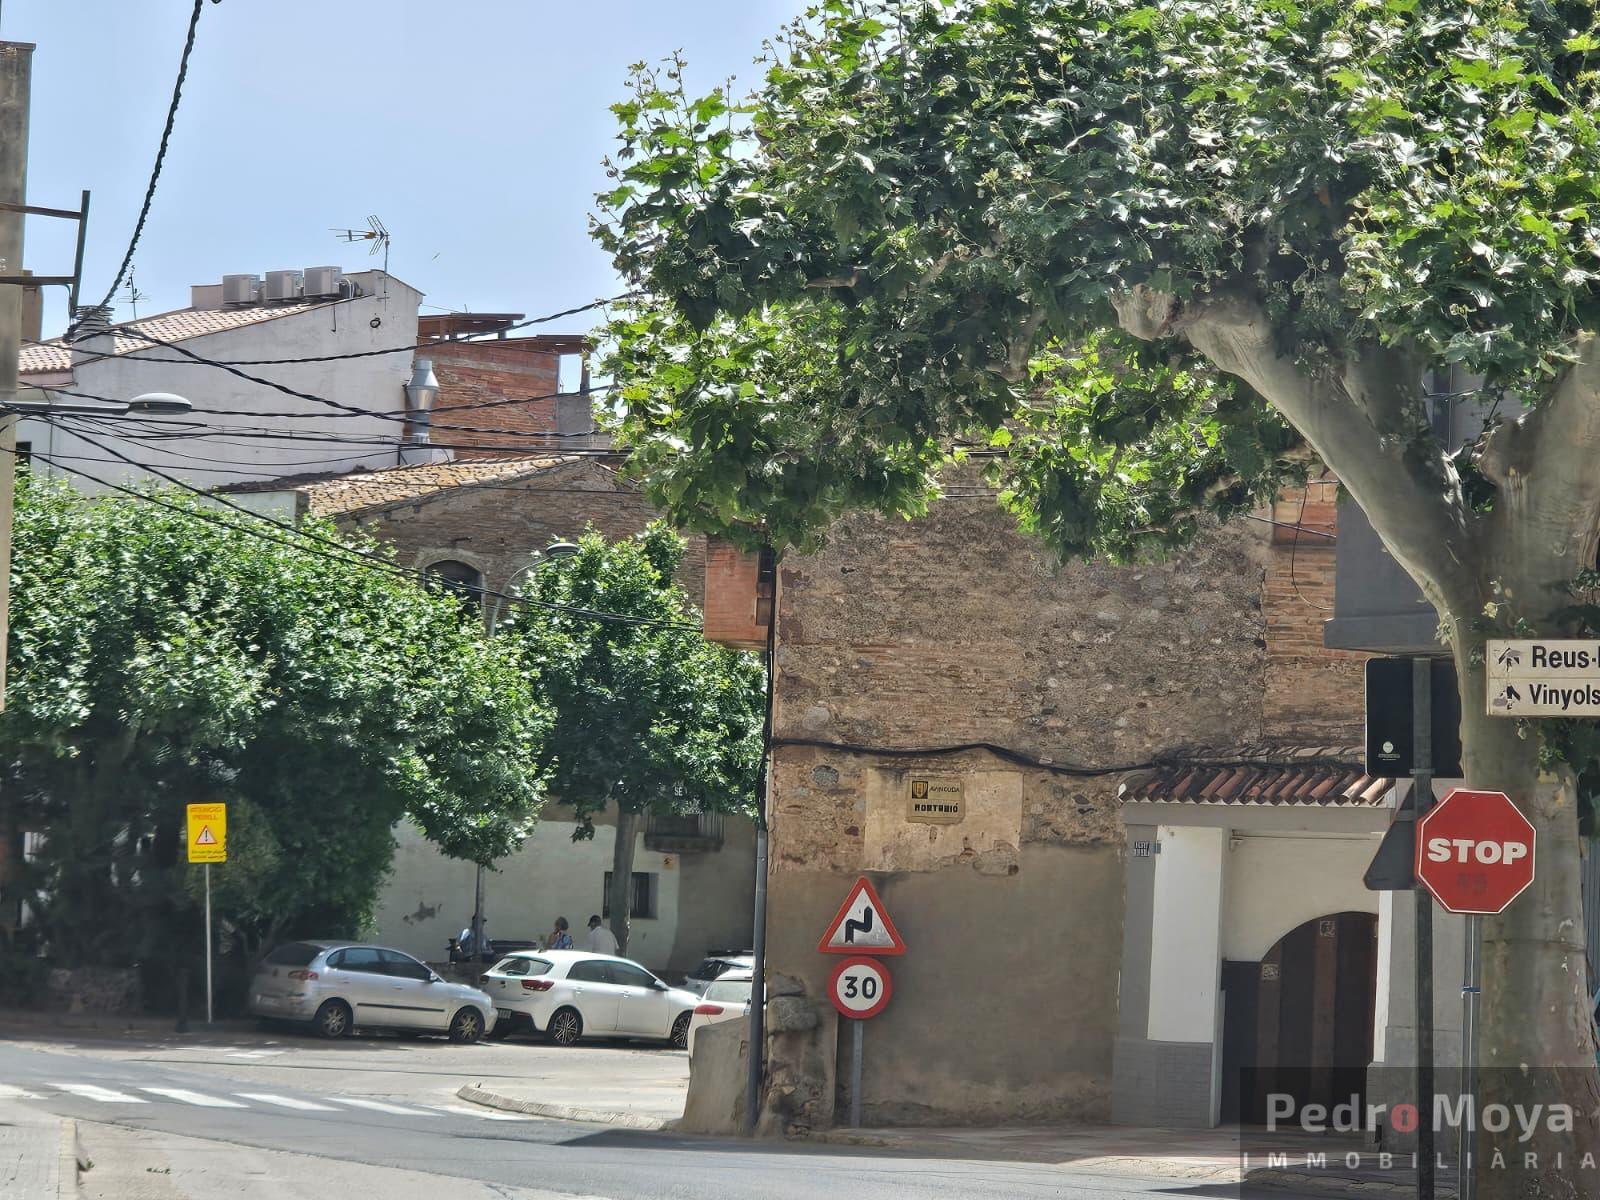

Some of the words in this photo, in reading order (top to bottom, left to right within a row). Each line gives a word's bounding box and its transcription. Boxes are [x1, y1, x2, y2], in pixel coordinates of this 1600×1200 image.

[1532, 645, 1600, 669] Reus-
[1529, 683, 1600, 711] Vinyols
[1427, 837, 1527, 865] STOP
[844, 976, 877, 1000] 30
